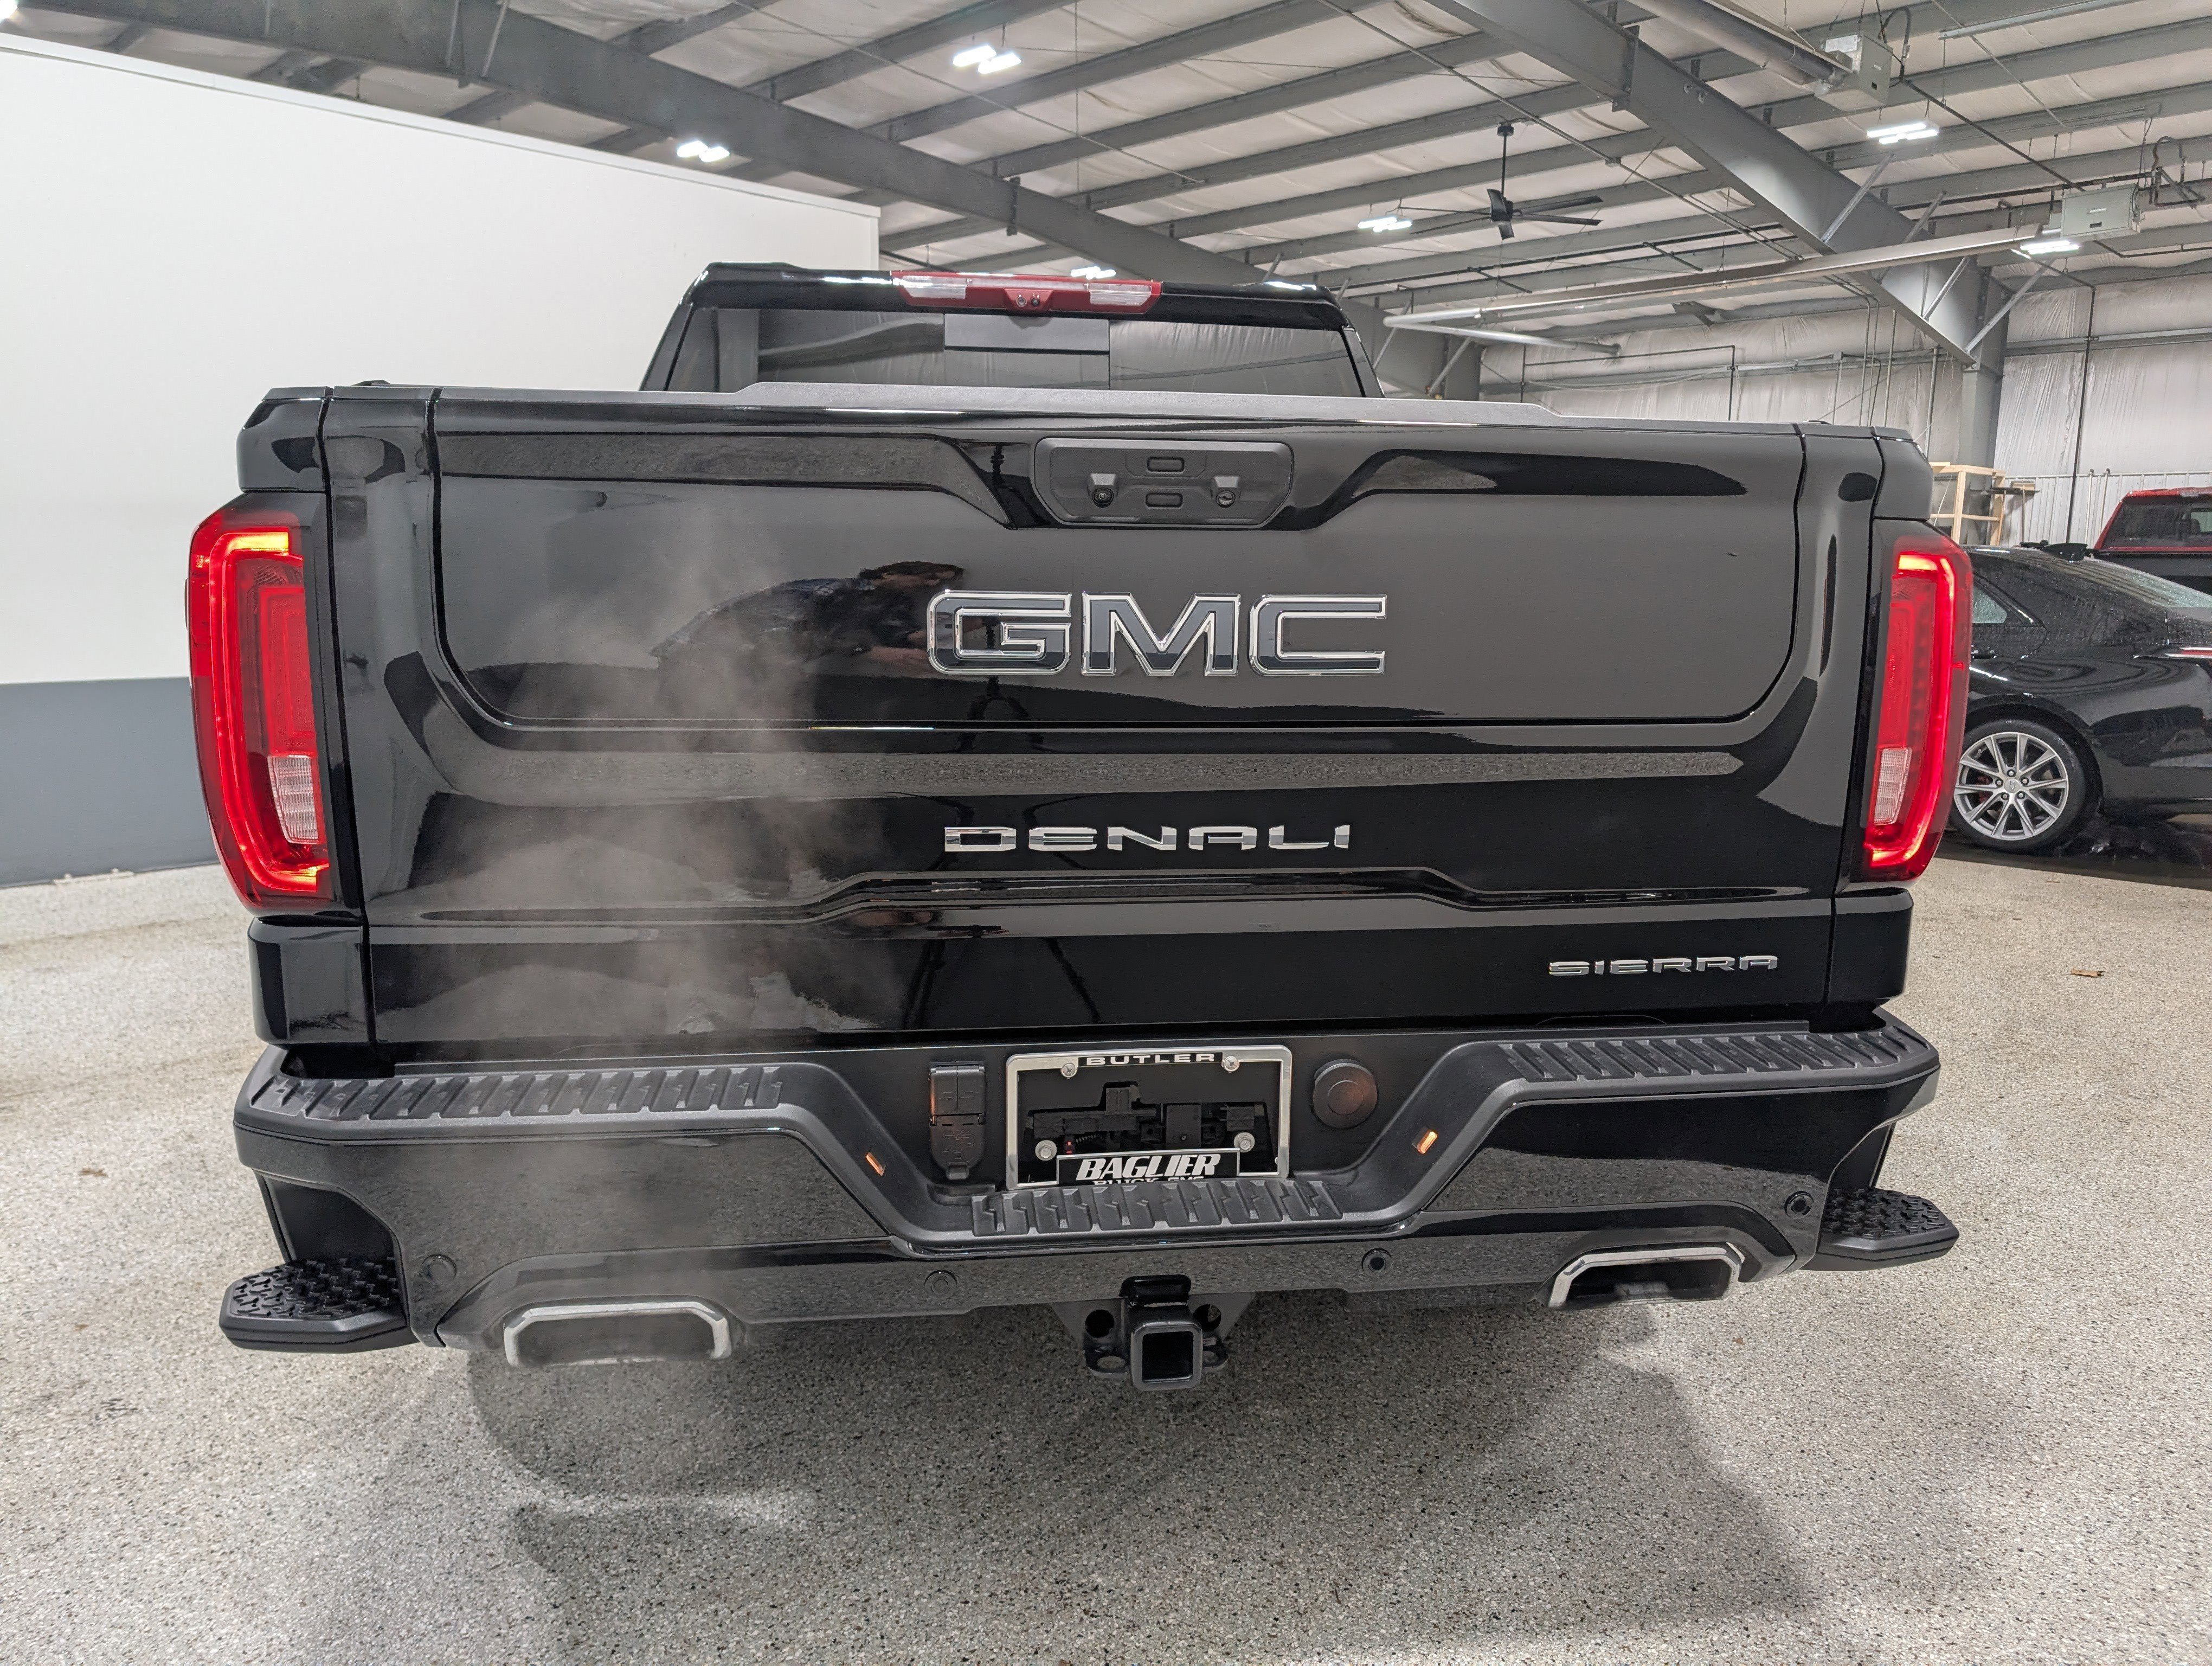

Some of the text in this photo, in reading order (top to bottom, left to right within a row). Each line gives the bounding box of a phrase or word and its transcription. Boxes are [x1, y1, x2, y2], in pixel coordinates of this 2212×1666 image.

[927, 589, 1387, 677] GMC
[944, 824, 1351, 852] DENALI
[1549, 955, 1778, 976] SIERRA
[1086, 1053, 1214, 1066] BUTLER
[1076, 1154, 1221, 1181] BAGLIER
